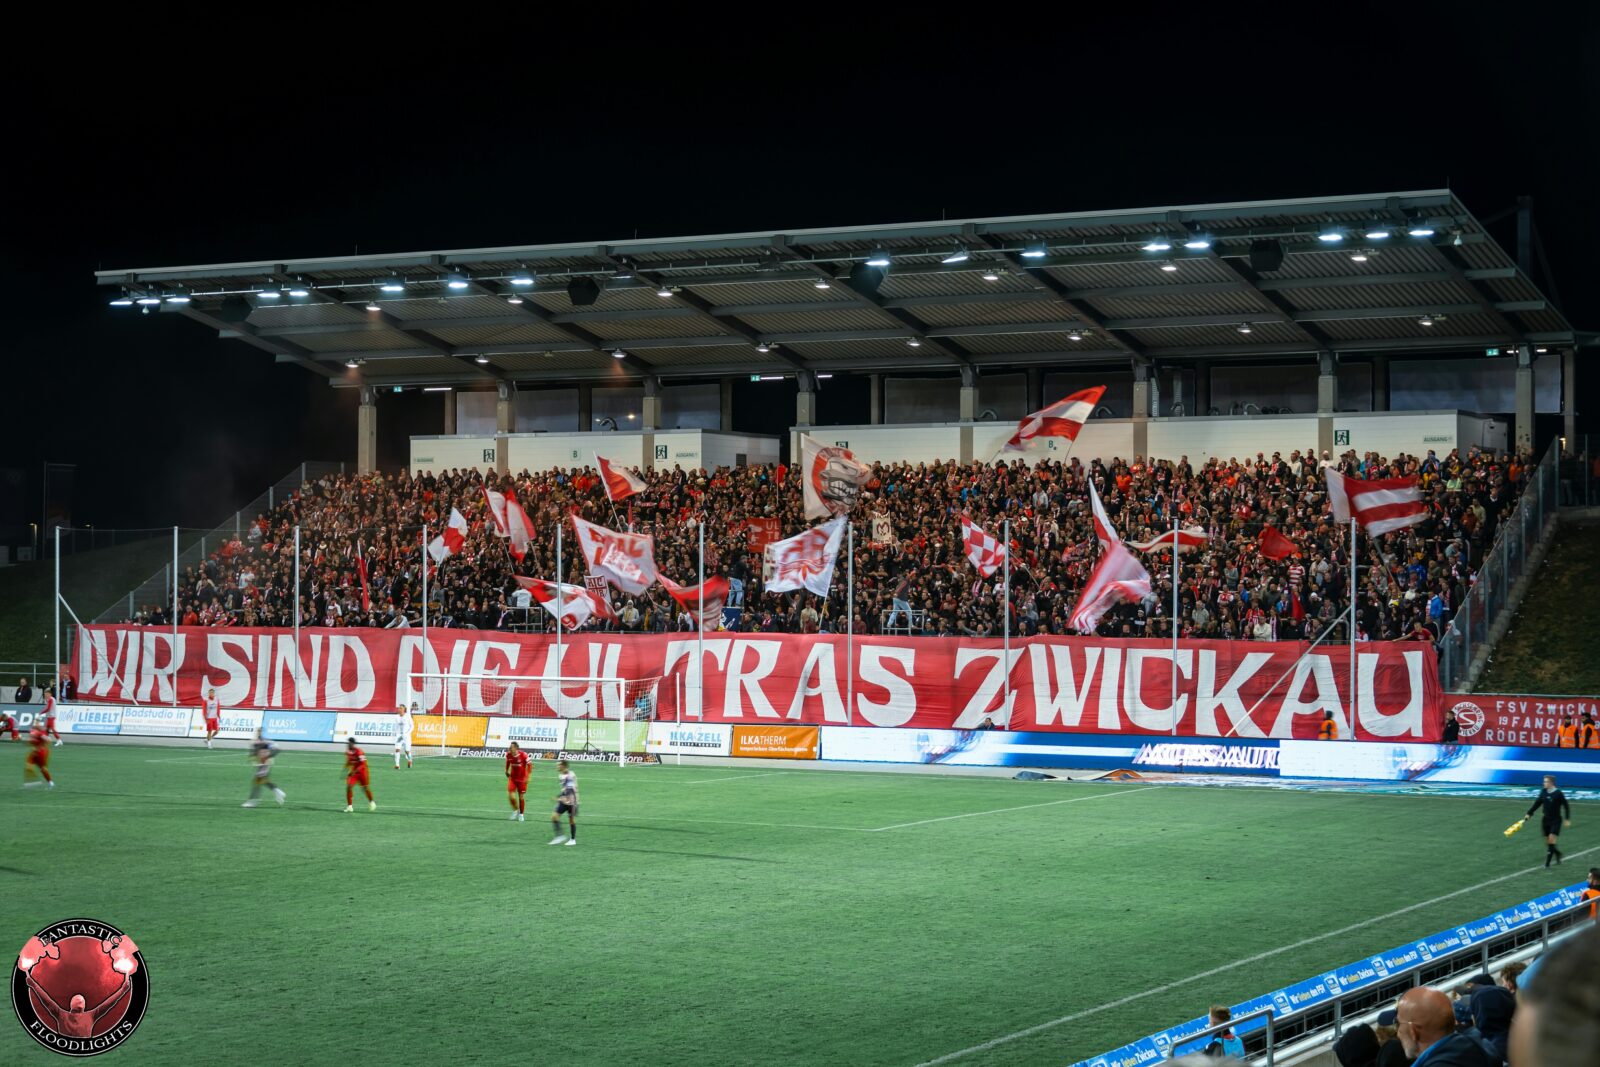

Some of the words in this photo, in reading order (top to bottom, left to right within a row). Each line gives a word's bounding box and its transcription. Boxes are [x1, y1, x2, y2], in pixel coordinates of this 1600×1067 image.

[78, 629, 187, 703] WIR
[201, 634, 376, 709] SIND
[395, 635, 520, 715] DIE
[952, 642, 1423, 739] ZWICKAU
[1496, 701, 1528, 714] FSV
[124, 708, 173, 719] Badstudio
[176, 710, 186, 720] in
[1498, 716, 1508, 725] 19
[740, 735, 788, 745] ILKATHERM
[460, 748, 507, 758] Eisenbach
[558, 751, 606, 762] Eisenbach
[1134, 1048, 1158, 1064] Zwickau
